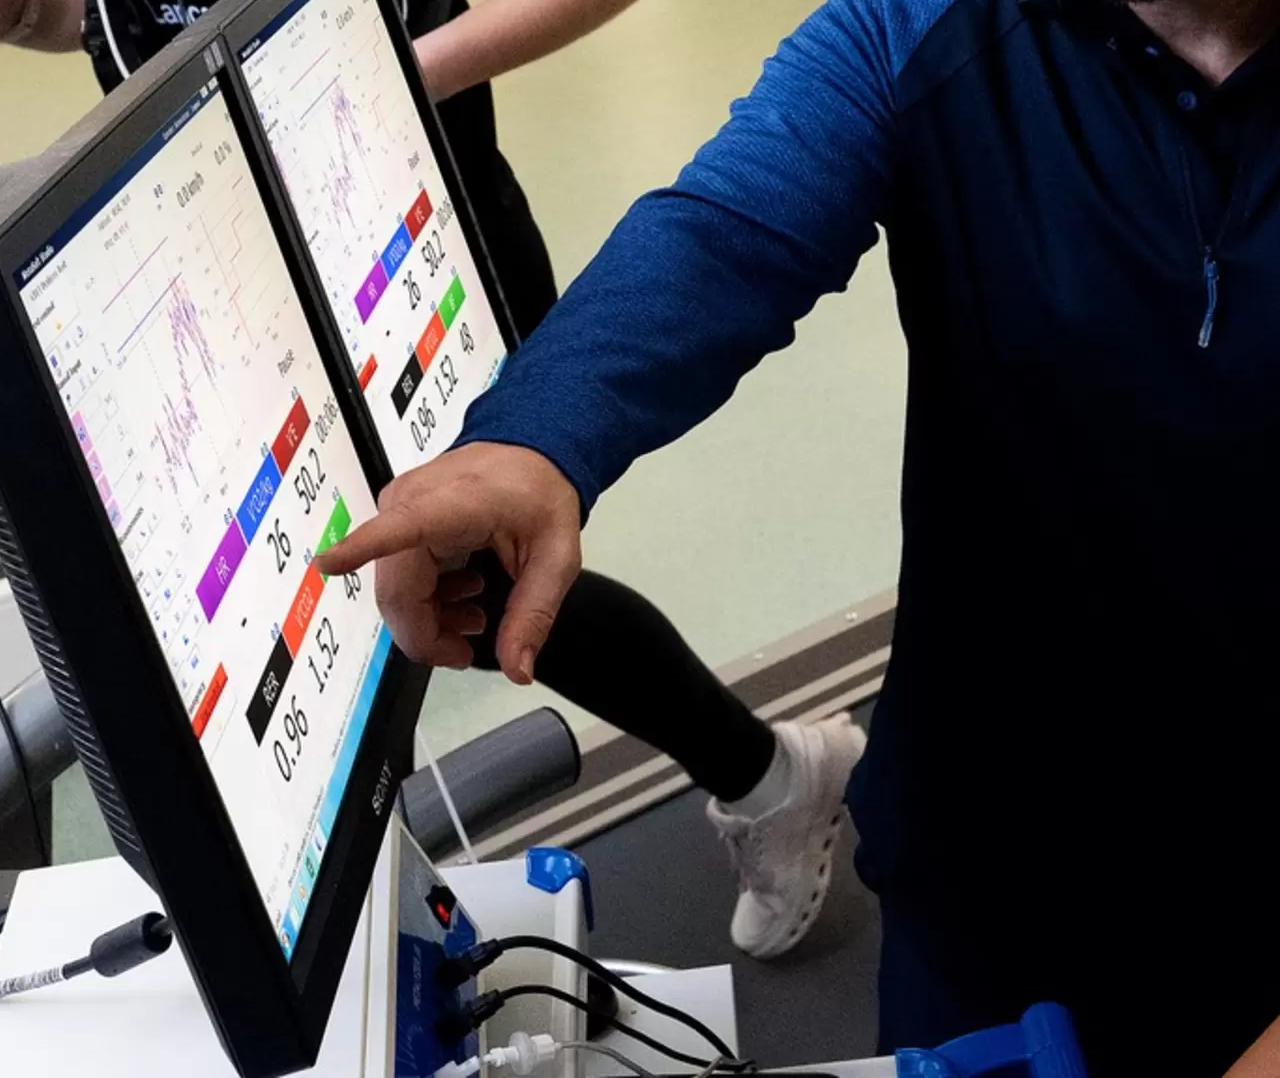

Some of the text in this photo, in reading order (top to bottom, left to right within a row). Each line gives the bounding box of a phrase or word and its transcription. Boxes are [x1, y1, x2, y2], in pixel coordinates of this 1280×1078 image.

[421, 230, 447, 277] 50.2
[403, 270, 421, 310] 26
[276, 347, 295, 380] Pause
[459, 322, 475, 356] 48
[434, 354, 459, 406] 1.52
[410, 397, 436, 452] 0.96
[293, 448, 327, 516] 50.2
[266, 517, 292, 575] 26
[308, 618, 340, 694] 1.52
[261, 670, 280, 708] RER
[272, 694, 309, 783] 0.96
[370, 759, 394, 817] SONY
